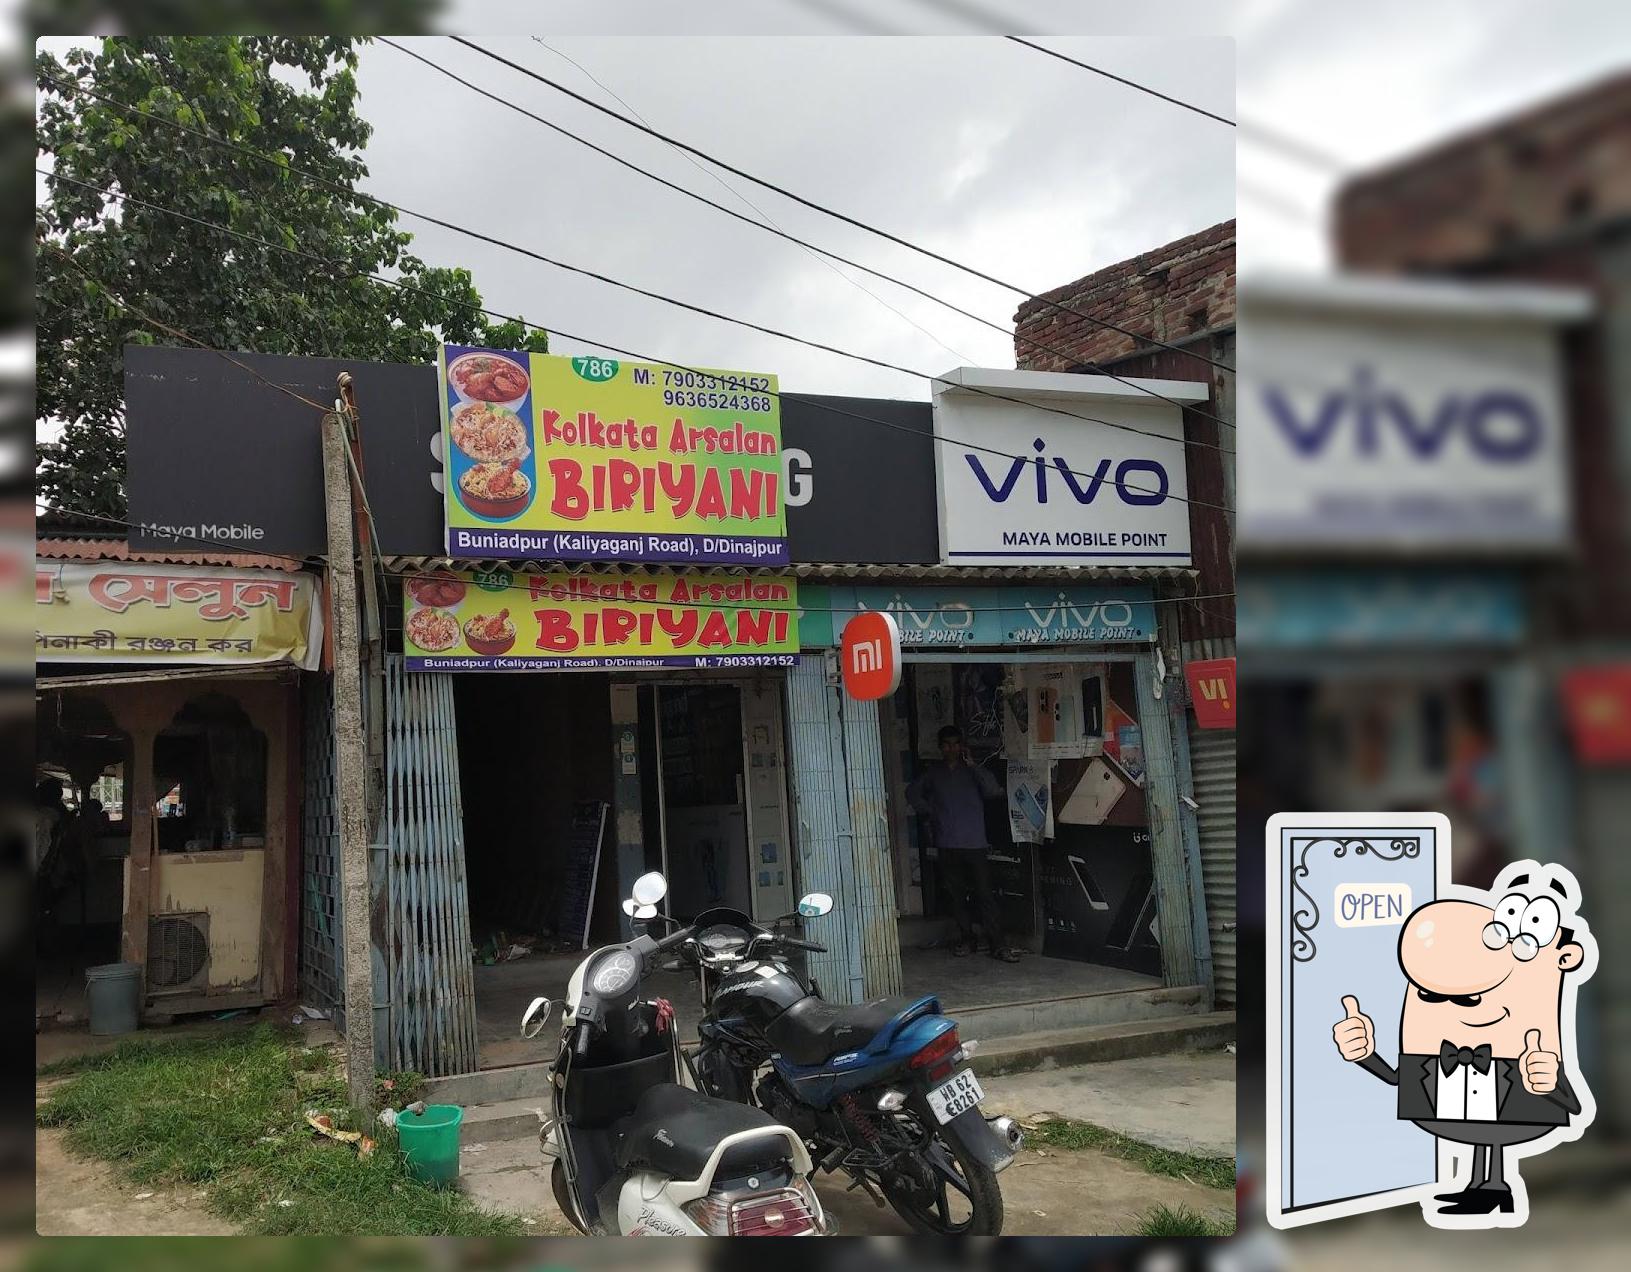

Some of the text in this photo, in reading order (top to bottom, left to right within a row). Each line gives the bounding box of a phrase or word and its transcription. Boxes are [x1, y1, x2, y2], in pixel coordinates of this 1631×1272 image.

[577, 358, 613, 378] 786
[633, 368, 770, 392] M: 7903312152
[663, 390, 771, 412] 9636524368
[542, 408, 778, 456] Kolkata Arsalan
[965, 437, 1169, 506] vivo
[548, 457, 779, 523] BIRIYANI
[140, 522, 265, 543] Maya Mobile
[1002, 531, 1168, 547] MAYA MOBILE POINT
[458, 532, 782, 558] Buniadpur (Kaliyaganj Road), D/Dinajpur
[478, 573, 509, 587] 786
[529, 575, 790, 604] Kolkata Arsalan
[87, 573, 298, 621] সেলুন
[1025, 592, 1133, 628] vivo
[533, 607, 790, 653] BIRIYANI
[928, 629, 966, 643] POINT
[1016, 627, 1135, 642] MAYA MOBILE POINT
[205, 638, 253, 653] কর
[424, 659, 489, 669] Buniadpur
[493, 659, 561, 669] (Kaliyaganj
[695, 655, 794, 667] M: 7903312152
[940, 1075, 972, 1101] WB 62
